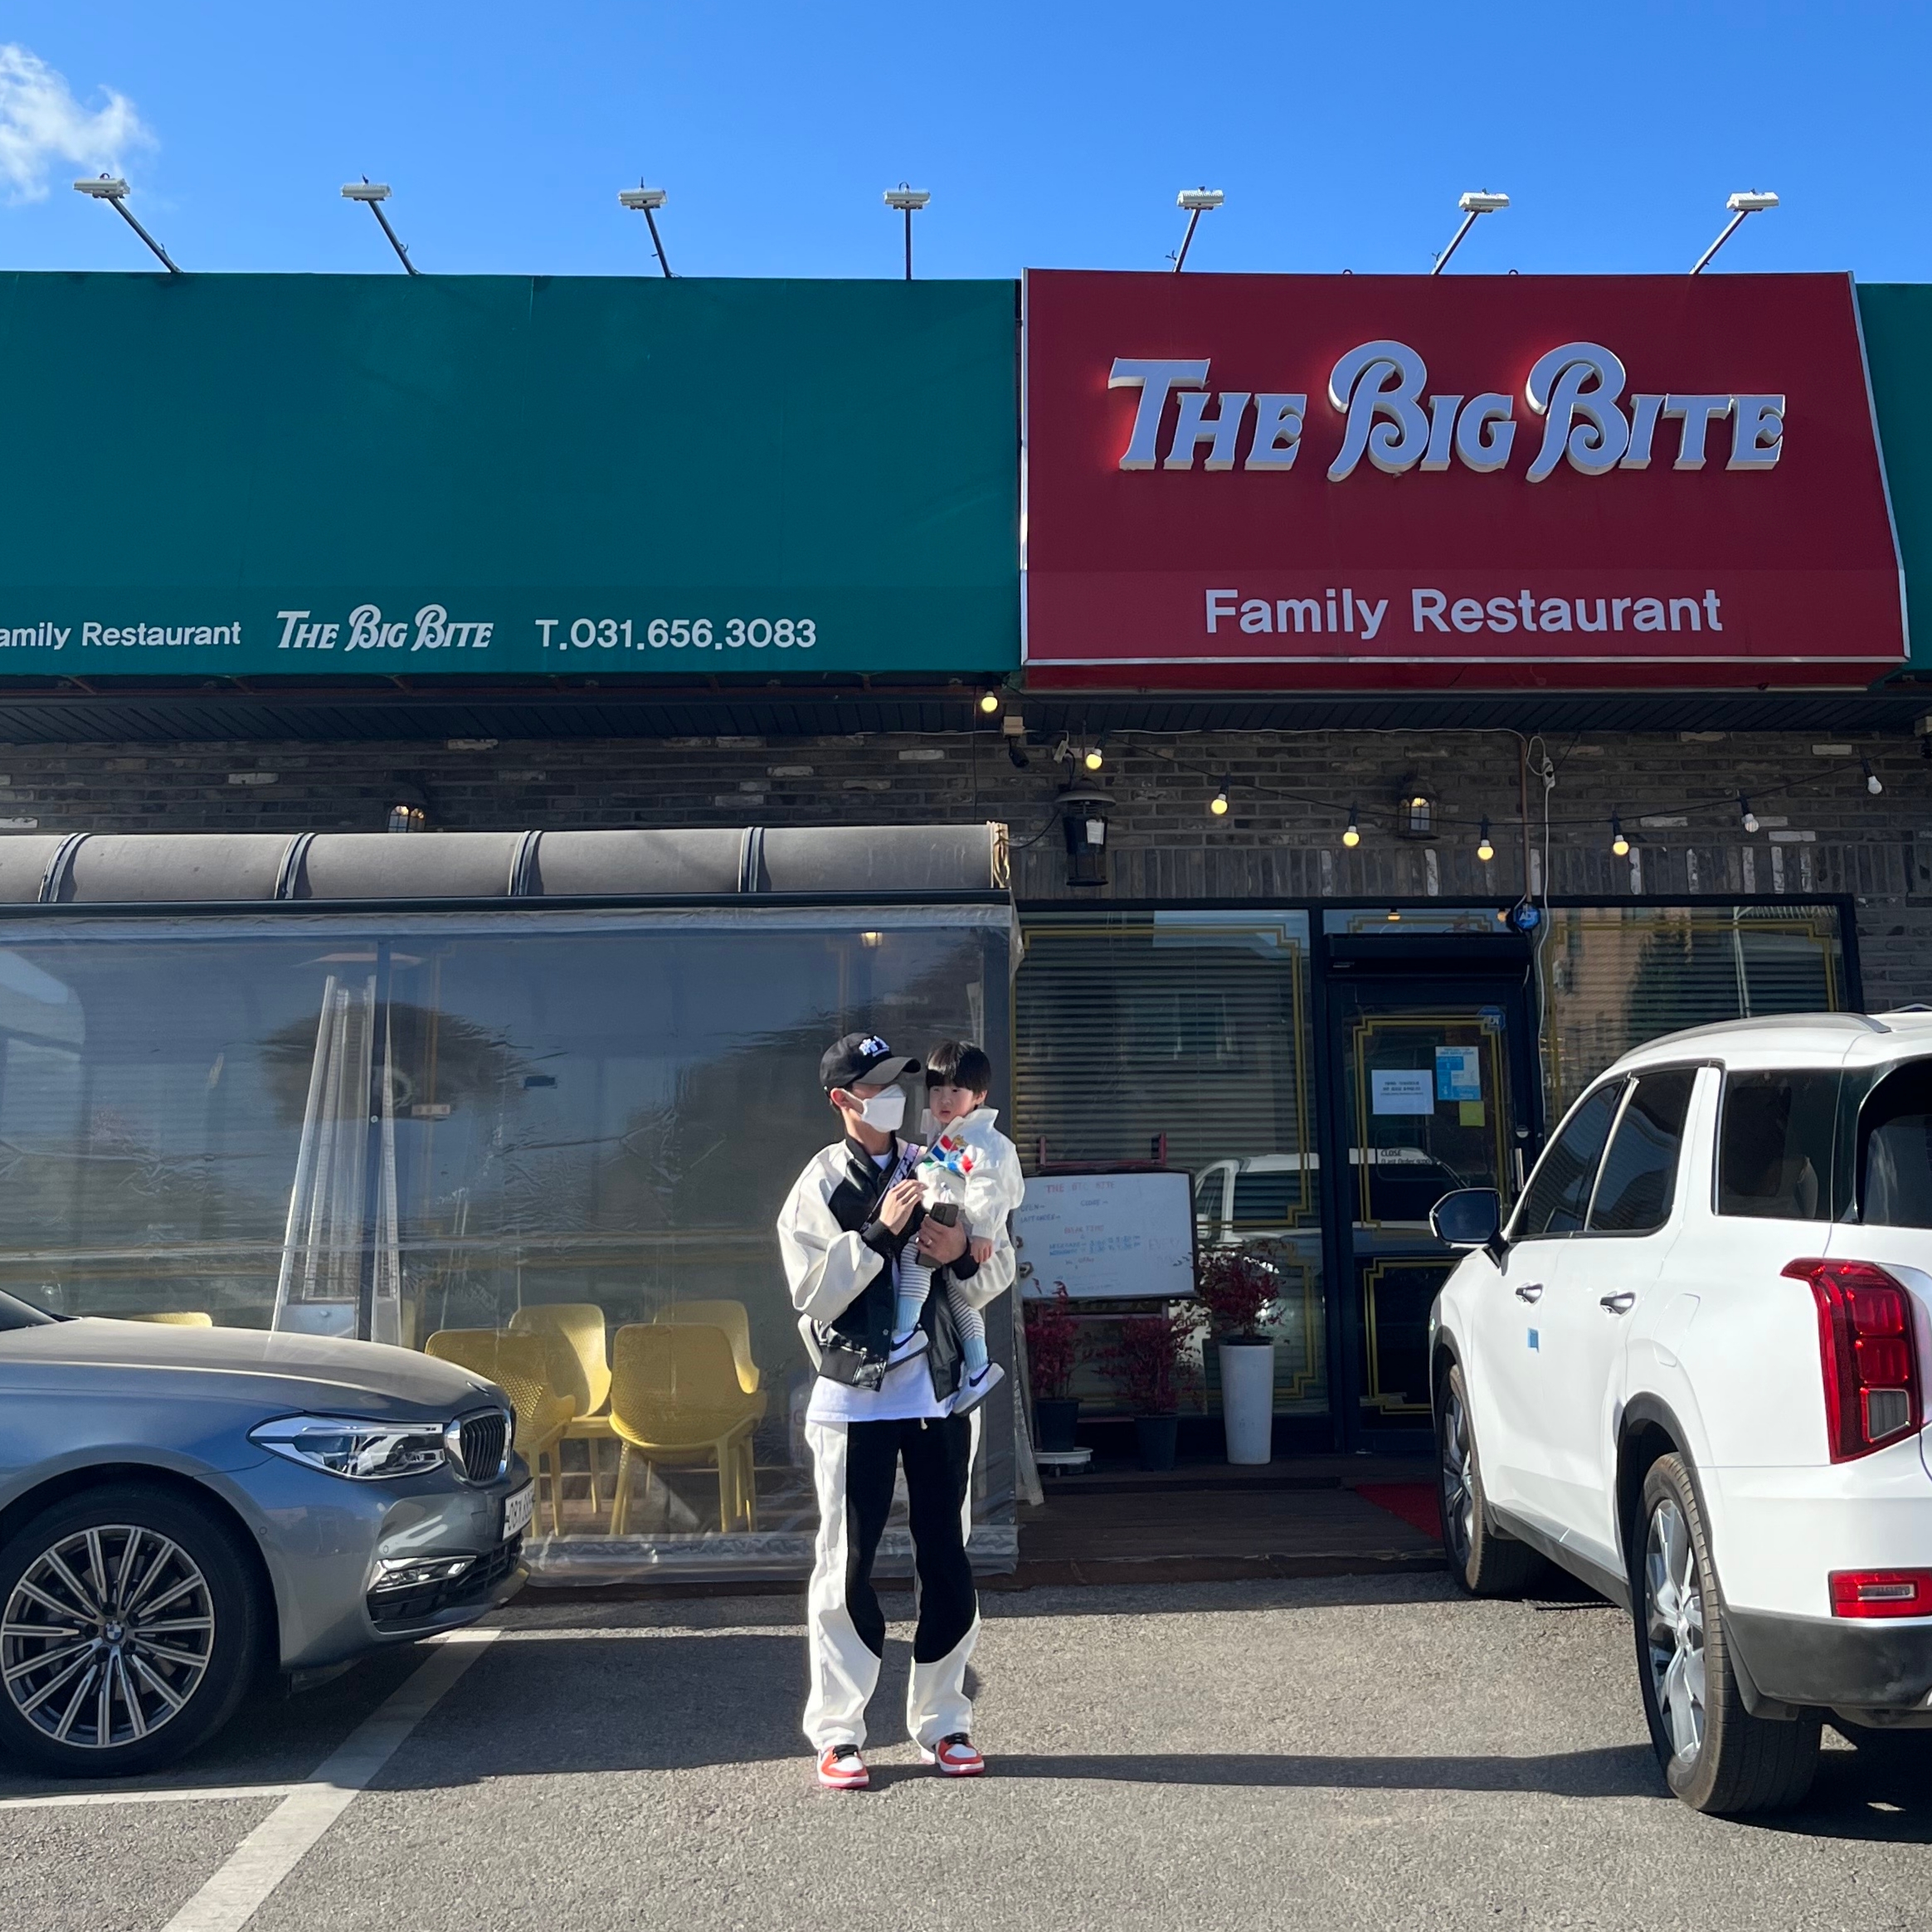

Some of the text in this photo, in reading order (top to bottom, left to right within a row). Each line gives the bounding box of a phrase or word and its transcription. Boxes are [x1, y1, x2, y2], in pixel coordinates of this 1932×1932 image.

[1107, 340, 1786, 483] THE BIG BITE
[83, 621, 241, 646] Restaurant
[276, 611, 339, 649] THE
[344, 604, 408, 651] BIG
[411, 604, 494, 651] BITE
[535, 618, 816, 650] T.031.656.3083
[1206, 588, 1723, 640] Family Restaurant
[1380, 1149, 1402, 1157] CLOSE
